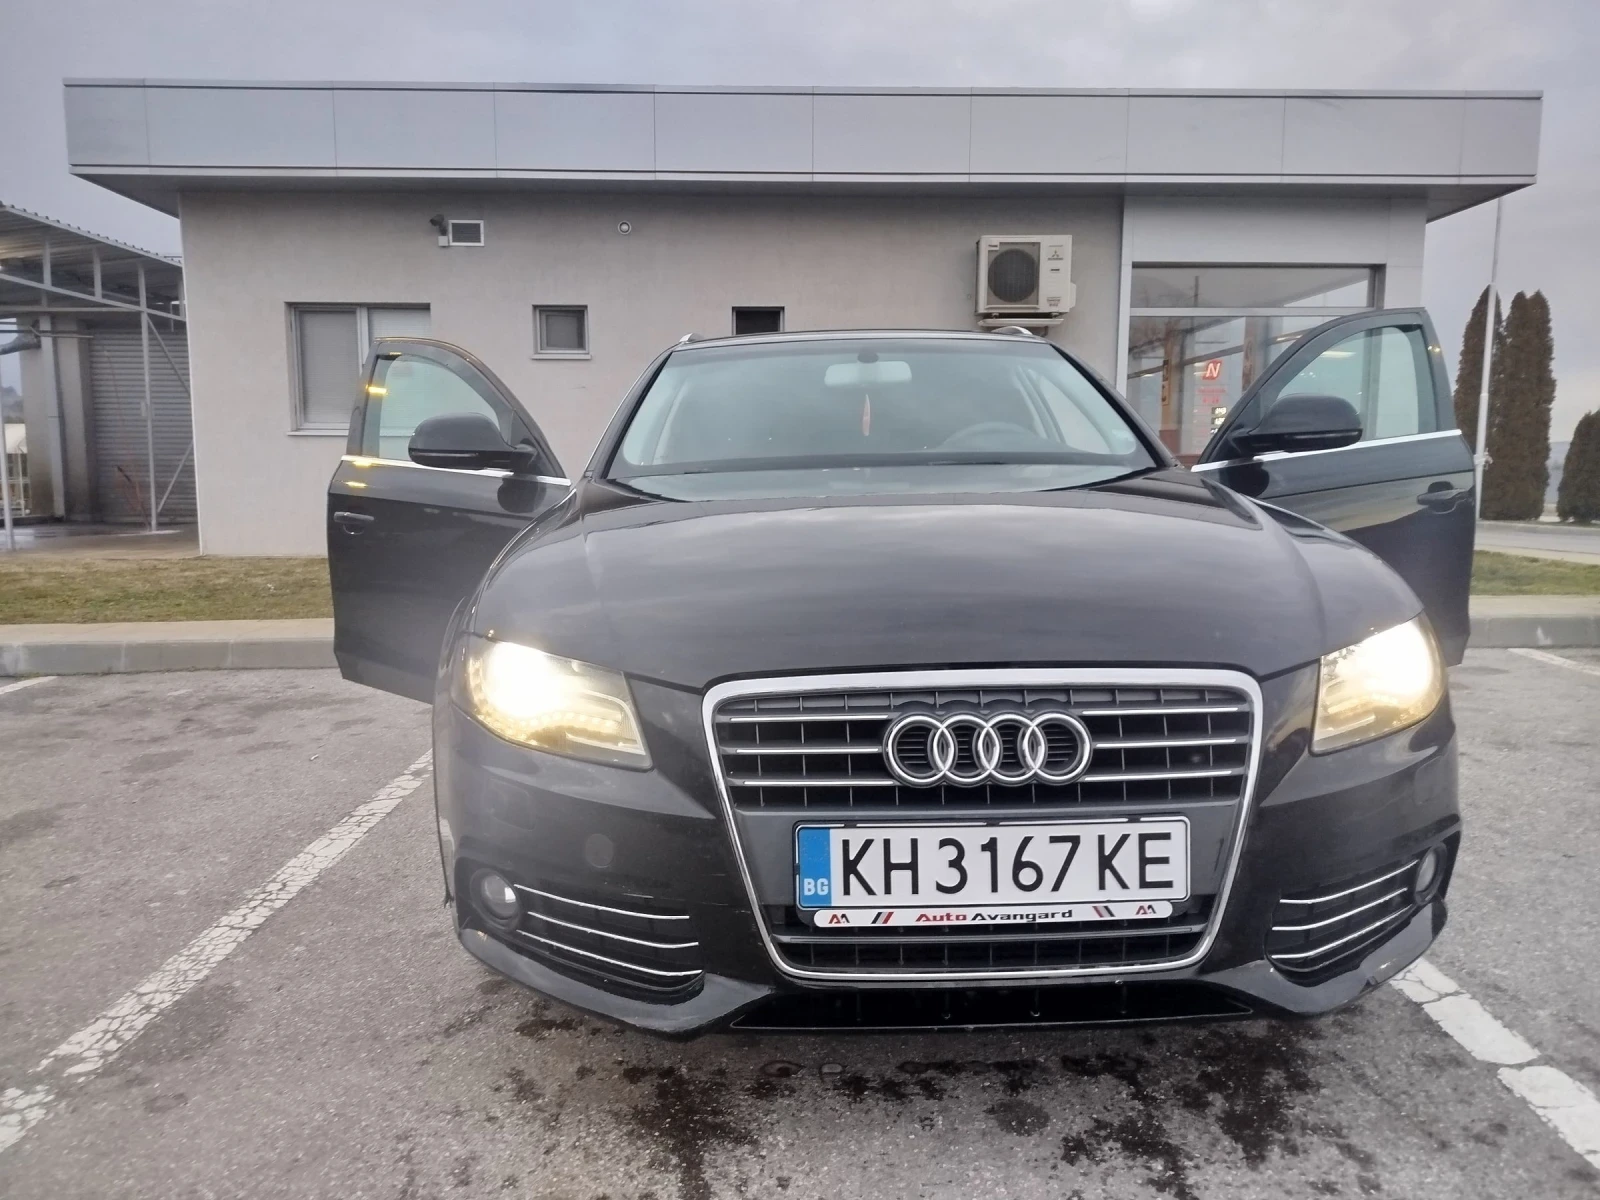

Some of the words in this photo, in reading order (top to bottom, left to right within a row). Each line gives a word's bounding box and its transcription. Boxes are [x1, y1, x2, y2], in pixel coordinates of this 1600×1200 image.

[841, 837, 919, 896] KH
[935, 835, 1081, 895] 3167
[1097, 832, 1174, 891] KE
[803, 878, 829, 896] BG
[915, 912, 967, 922] Auto
[970, 909, 1073, 923] Avangard
